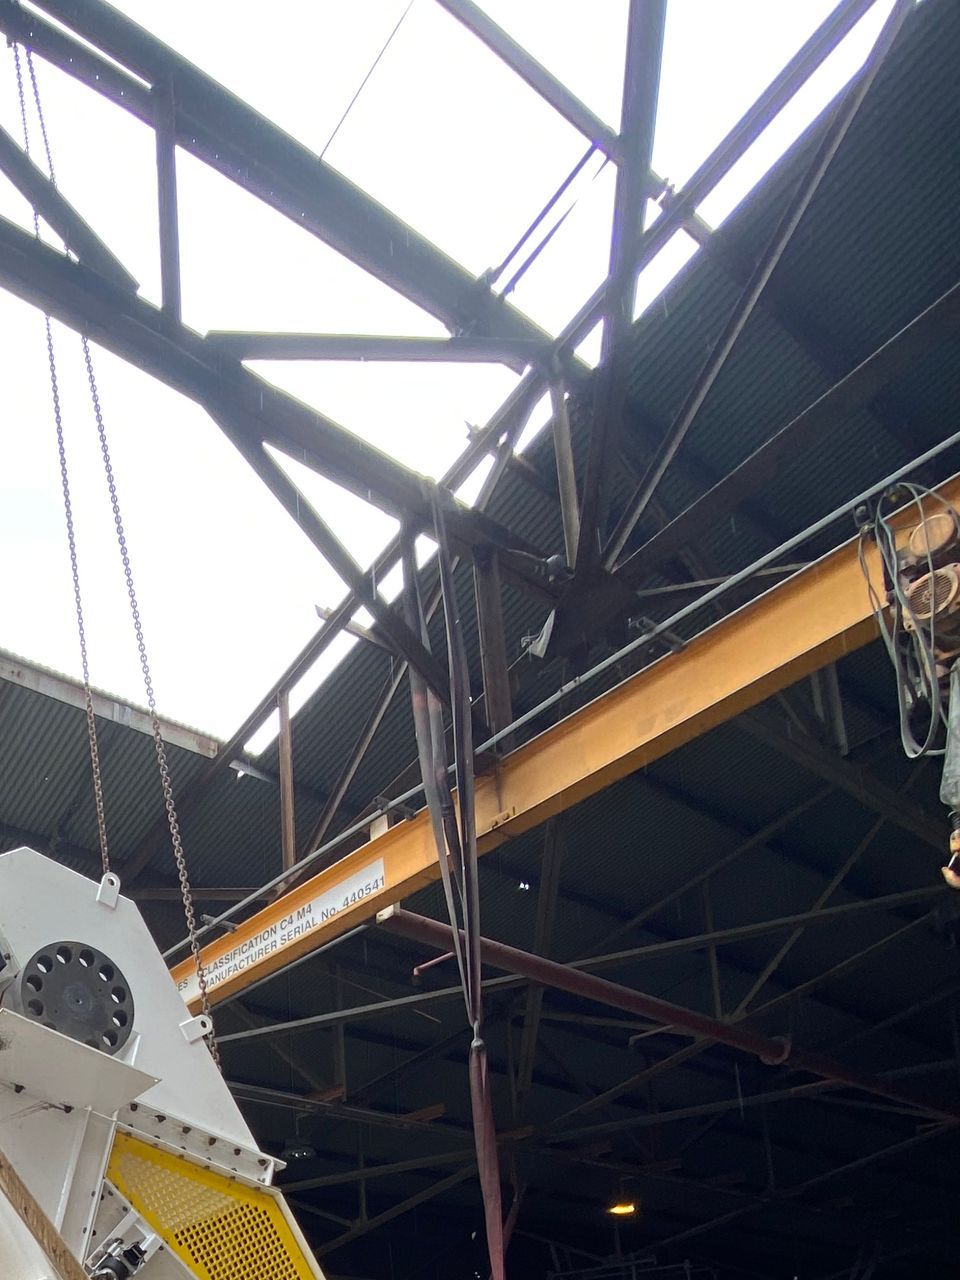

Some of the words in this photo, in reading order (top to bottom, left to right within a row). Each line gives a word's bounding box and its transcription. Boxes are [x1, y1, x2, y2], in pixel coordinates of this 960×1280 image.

[202, 923, 278, 979] CLASSIFICATION
[280, 916, 294, 931] C4
[296, 903, 313, 922] M4
[280, 917, 318, 945] SERIAL
[321, 906, 340, 922] No.
[342, 875, 385, 908] 440541
